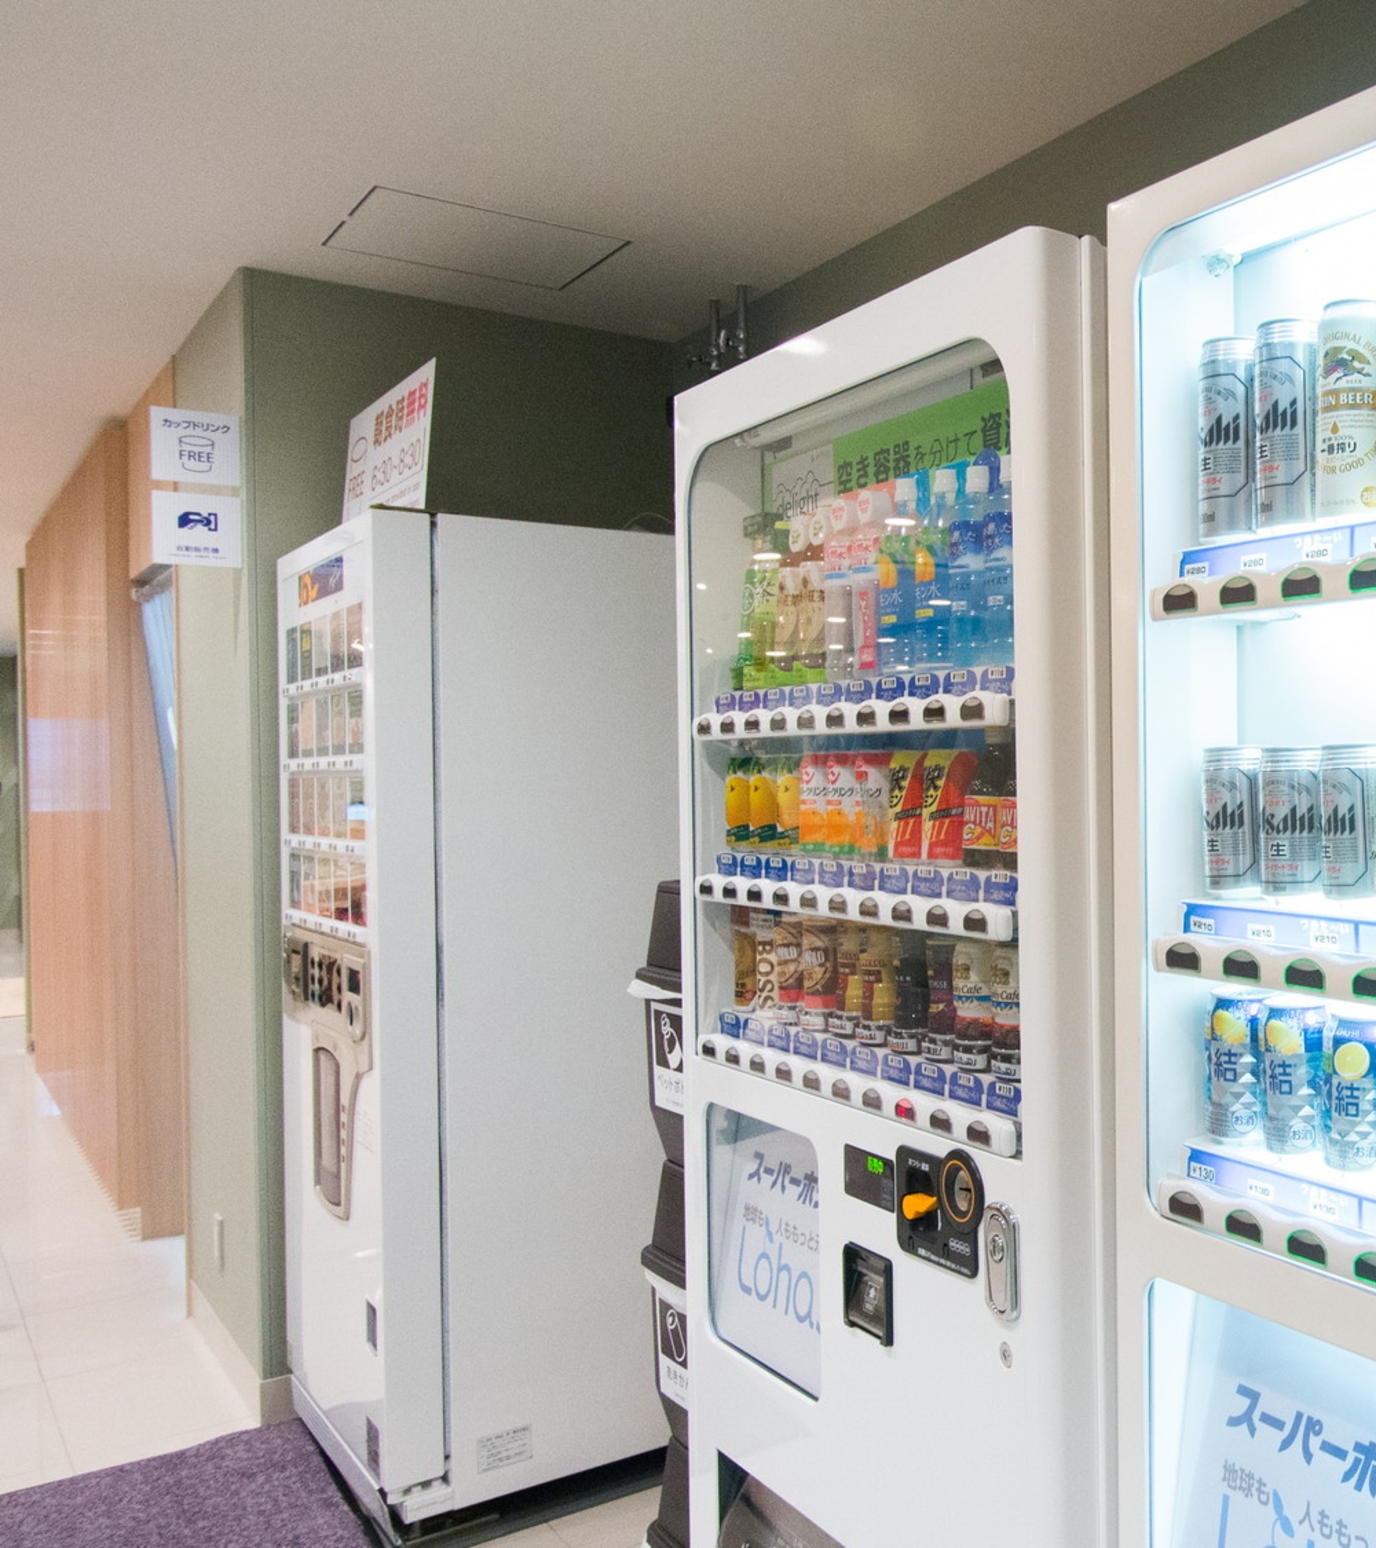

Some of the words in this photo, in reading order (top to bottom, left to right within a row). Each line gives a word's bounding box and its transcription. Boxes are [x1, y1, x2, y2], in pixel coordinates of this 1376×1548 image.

[1340, 391, 1374, 405] BEER
[161, 418, 230, 434] カップドリンク
[179, 449, 215, 464] FREE
[837, 409, 1010, 495] 空き容器を分けて資
[1339, 457, 1365, 474] GOOD
[1305, 548, 1329, 558] ¥280
[1270, 842, 1287, 857] 生
[1191, 919, 1213, 932] ¥210
[1250, 928, 1272, 939] ¥210
[1313, 933, 1338, 945] ¥210
[757, 940, 775, 1010] BOSS
[961, 984, 982, 994] Cafe
[1213, 1048, 1237, 1083] 結
[1269, 1060, 1293, 1096] 結
[1335, 1082, 1360, 1118] 結
[1233, 1113, 1255, 1127] お酒
[1291, 1127, 1312, 1141] お酒
[1354, 1144, 1376, 1158] お酒
[1192, 1164, 1214, 1182] ¥130
[1312, 1204, 1336, 1216] ¥130
[738, 1225, 820, 1334] Loha
[1222, 1459, 1270, 1507] 地球も
